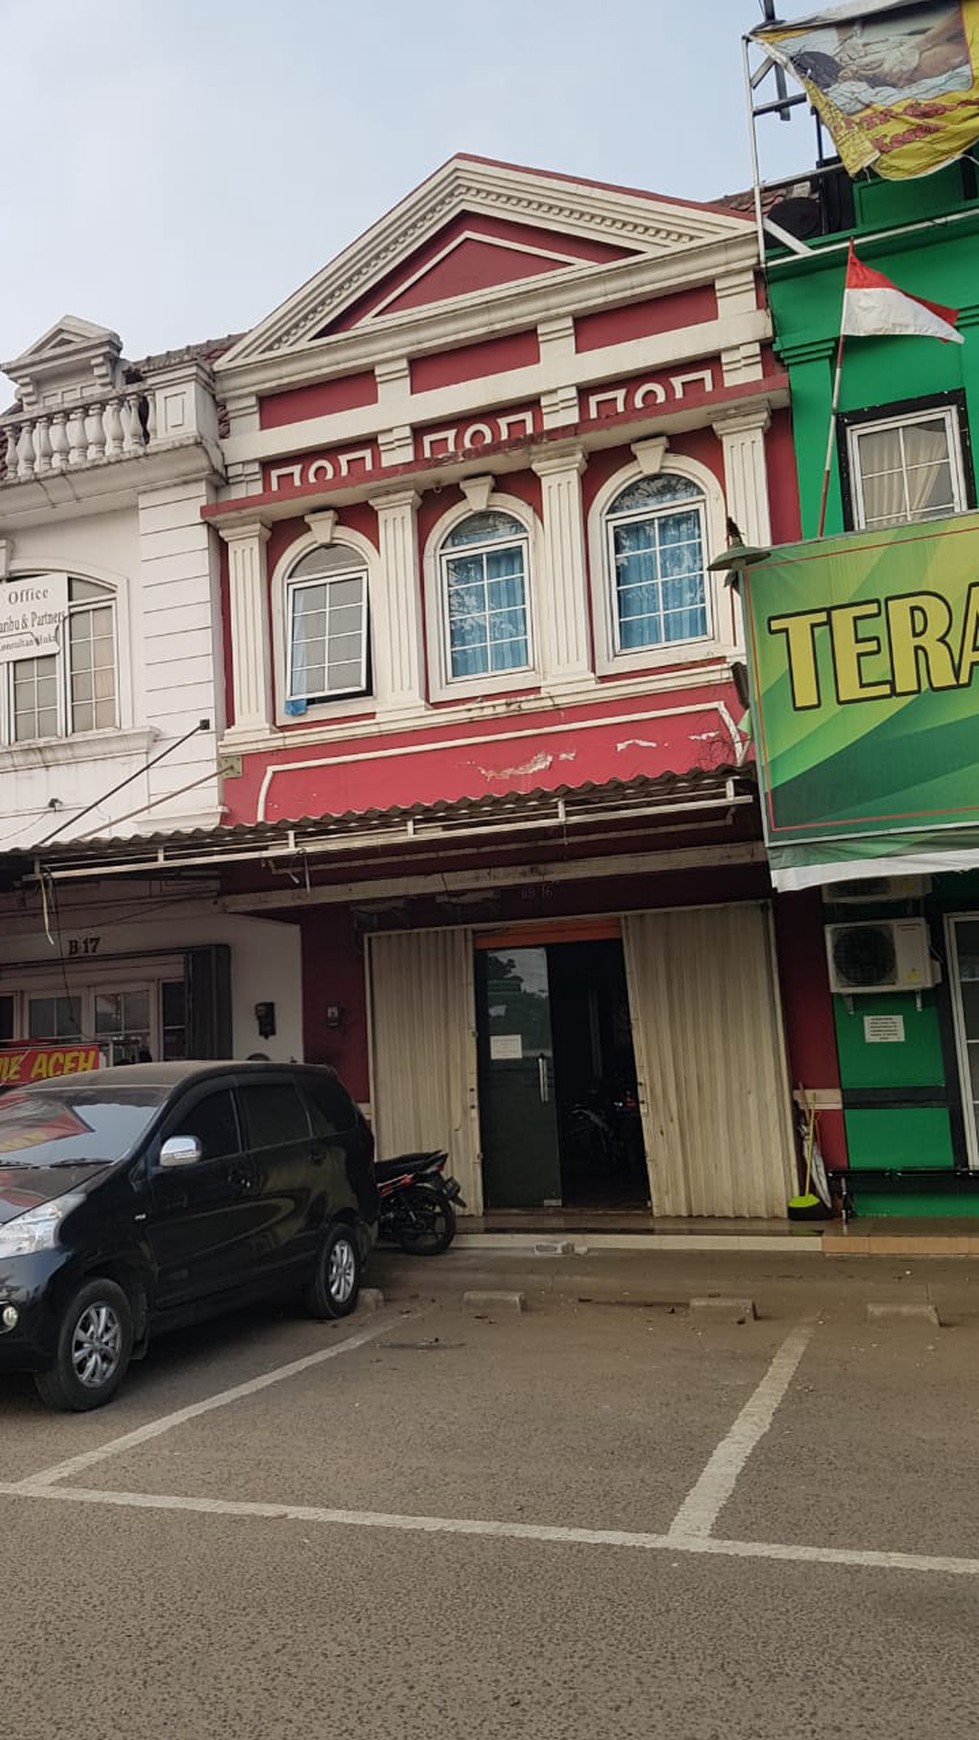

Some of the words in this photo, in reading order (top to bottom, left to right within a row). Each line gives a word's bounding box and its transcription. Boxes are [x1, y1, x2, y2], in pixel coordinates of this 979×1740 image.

[8, 588, 49, 605] Office
[21, 613, 29, 630] &
[30, 1050, 96, 1079] ACEH
